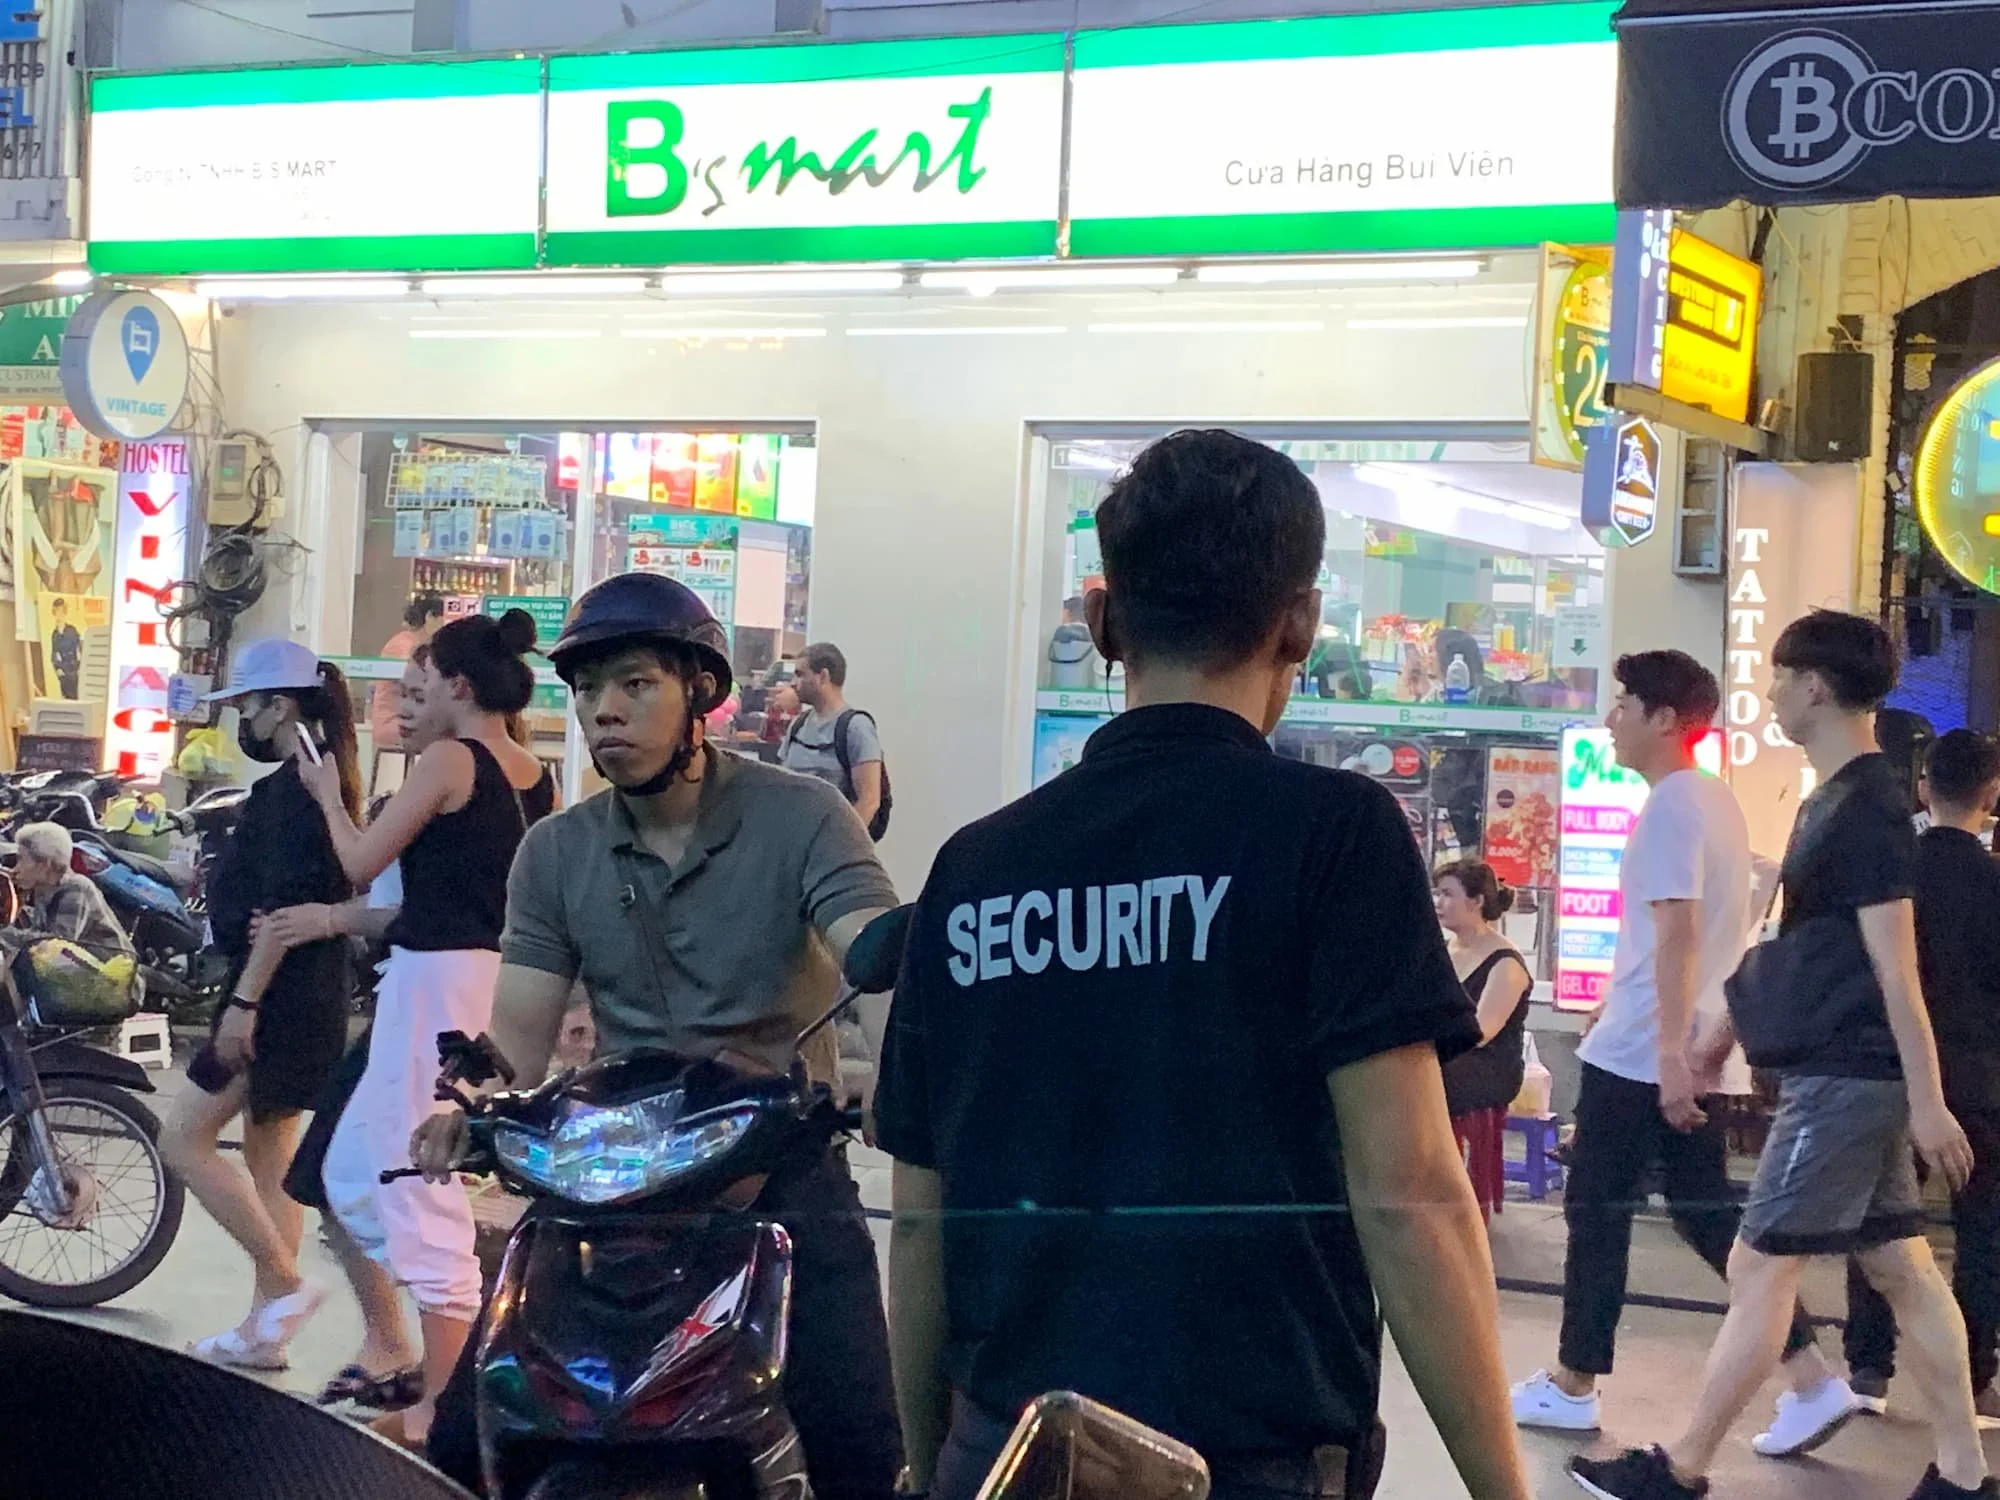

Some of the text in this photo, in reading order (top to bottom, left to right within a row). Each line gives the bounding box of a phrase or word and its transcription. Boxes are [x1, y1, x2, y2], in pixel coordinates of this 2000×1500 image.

[738, 86, 992, 196] mart
[287, 159, 337, 177] MART
[106, 397, 168, 417] VINTAGE
[122, 442, 189, 475] HOSTEL
[1730, 528, 1768, 766] TATTOO
[1563, 893, 1612, 914] FOOT
[947, 875, 1232, 987] SECURITY
